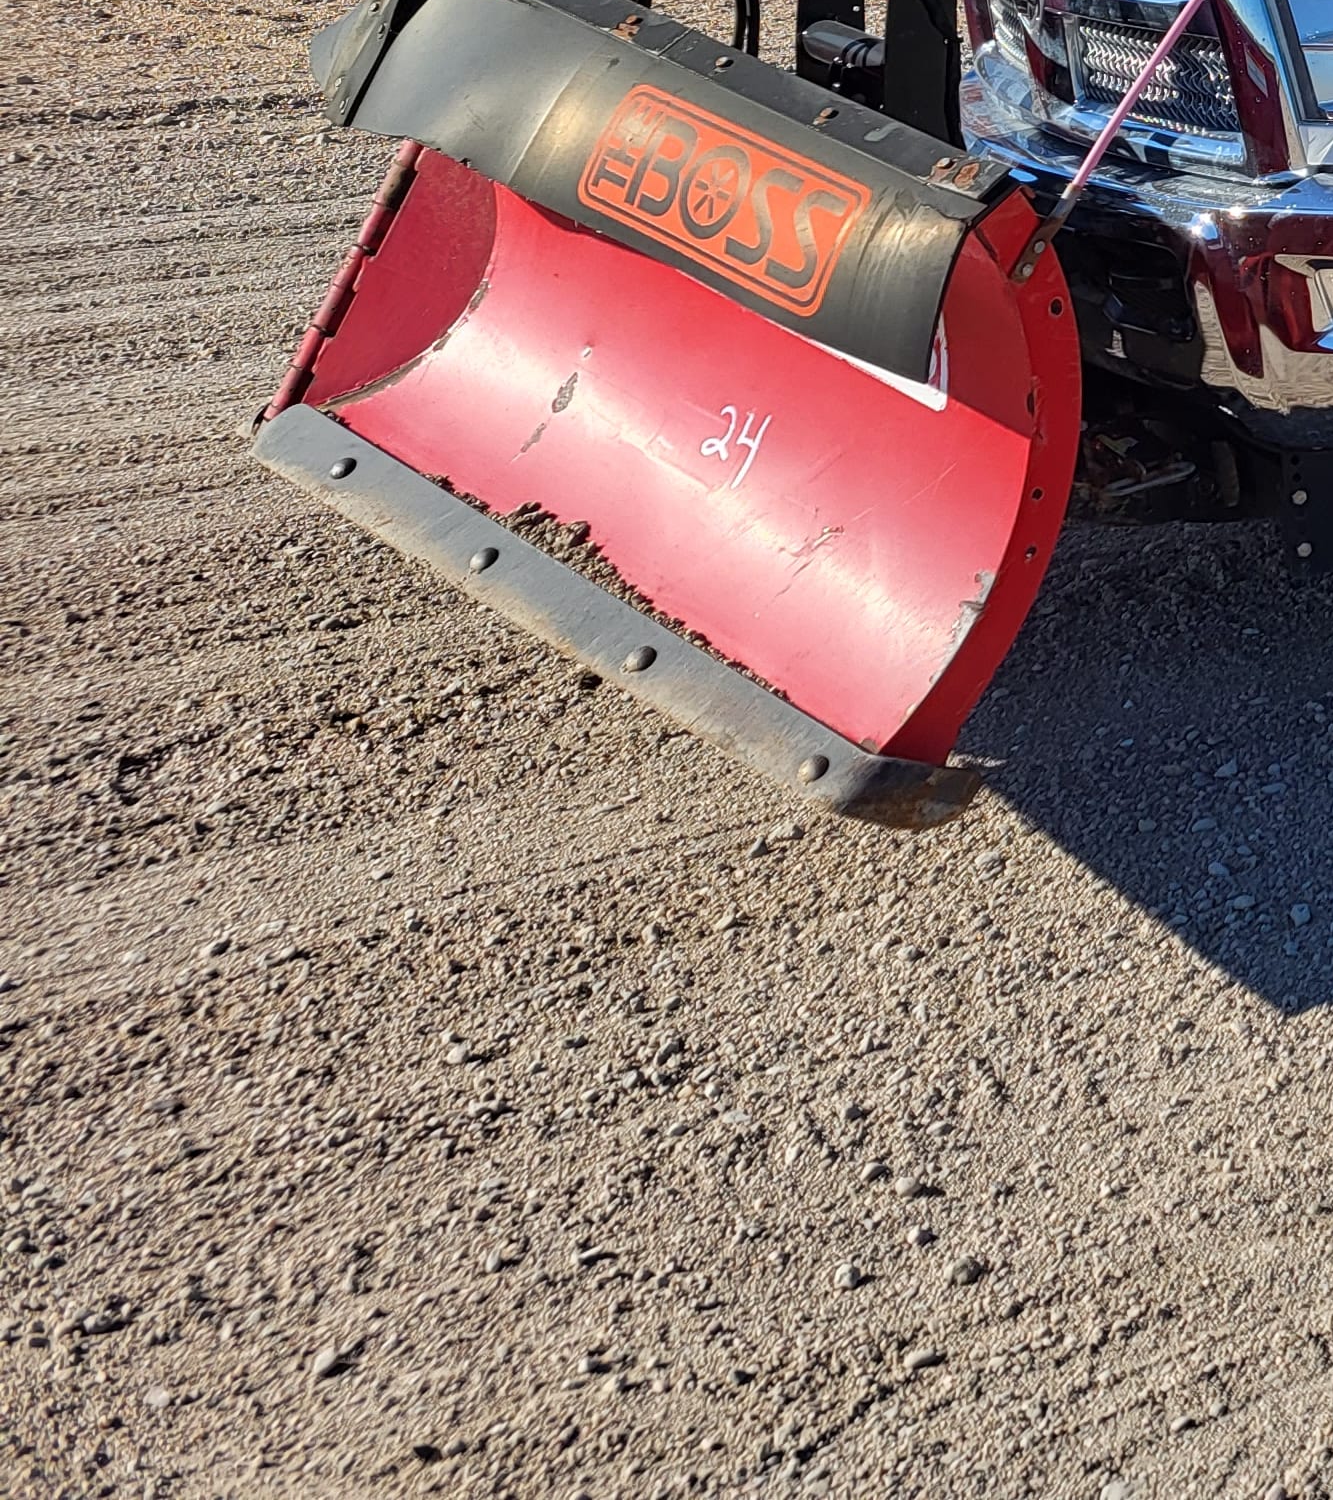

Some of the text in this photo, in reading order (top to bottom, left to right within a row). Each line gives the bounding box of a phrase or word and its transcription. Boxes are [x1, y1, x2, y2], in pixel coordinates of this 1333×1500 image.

[590, 98, 849, 290] THE BOSS
[700, 403, 773, 490] 24
